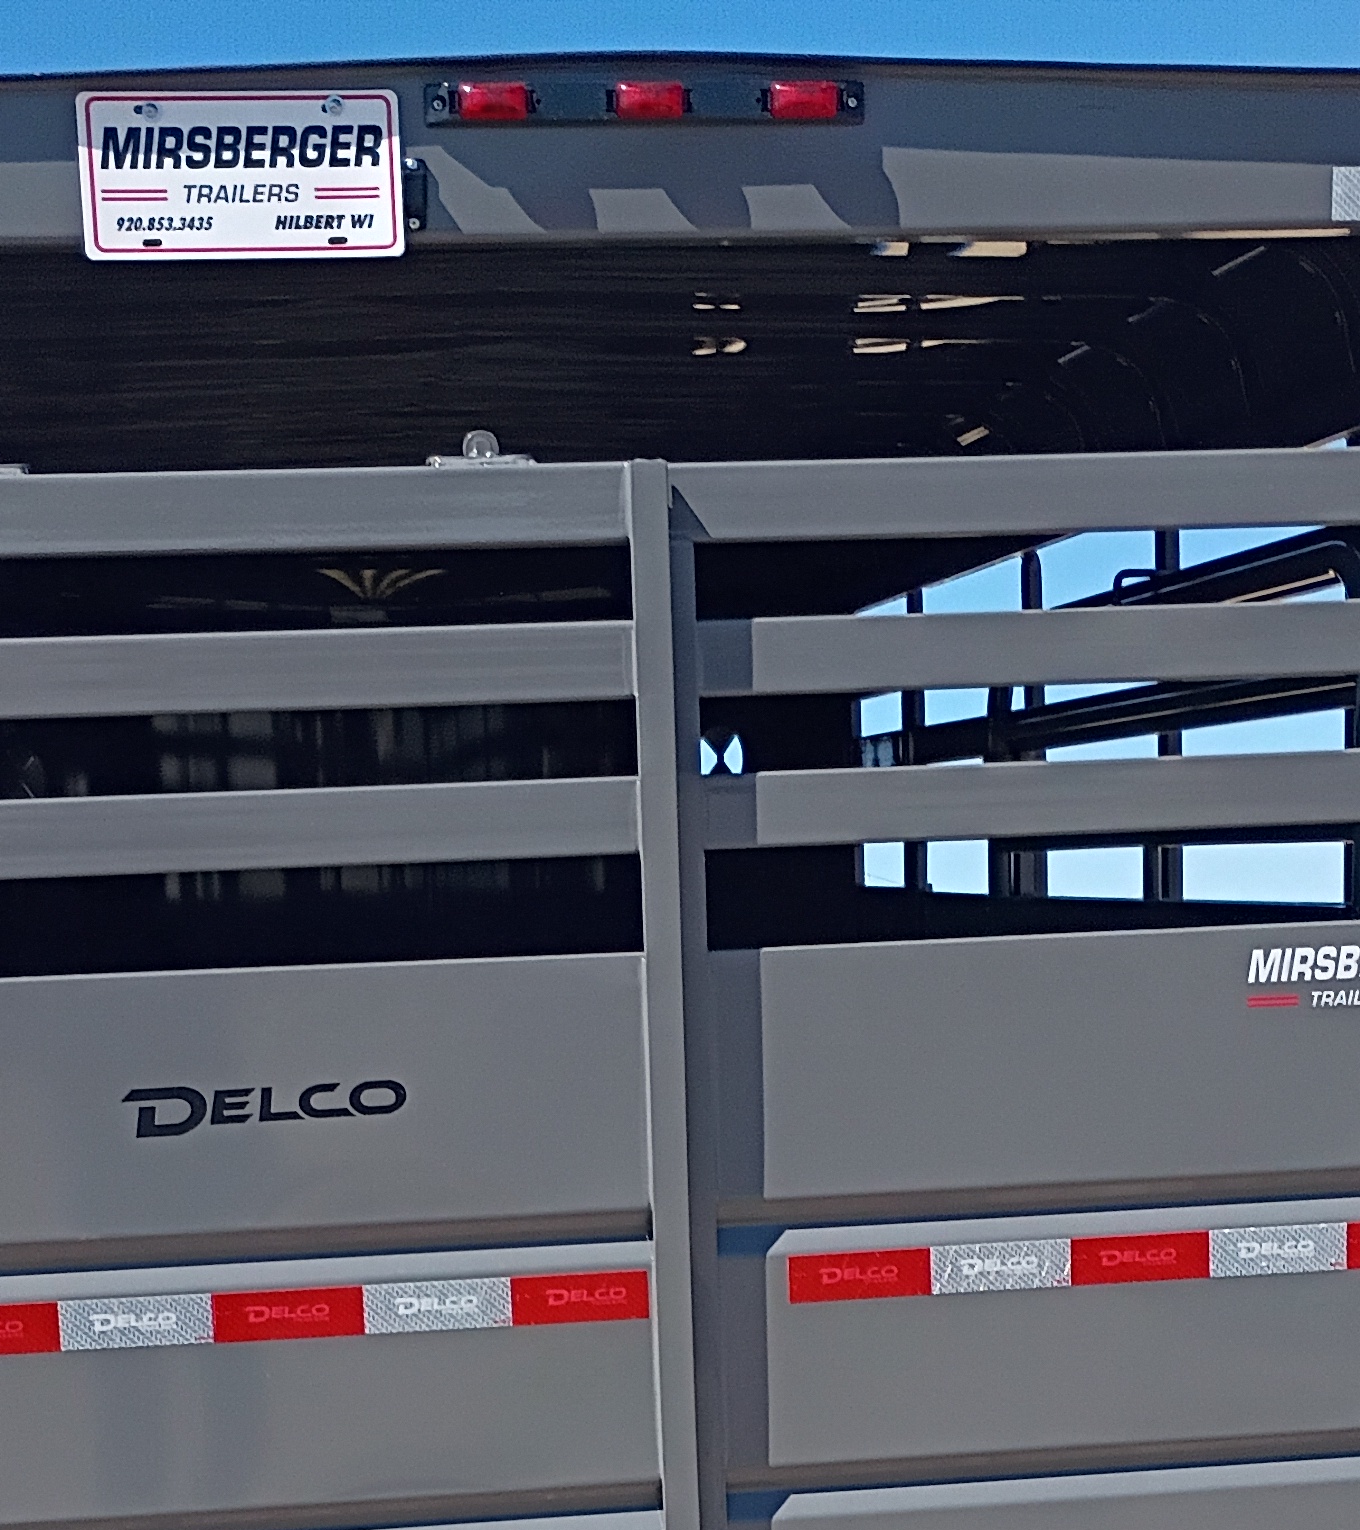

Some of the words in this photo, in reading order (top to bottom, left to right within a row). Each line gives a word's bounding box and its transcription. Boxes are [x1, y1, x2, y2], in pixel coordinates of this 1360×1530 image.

[100, 125, 383, 170] MIRSBERGER
[183, 183, 300, 204] TRAILERS
[115, 216, 214, 232] 920.853.3435
[274, 214, 346, 231] HILBERT
[349, 213, 375, 229] WI
[120, 1078, 408, 1139] DELCO
[545, 1287, 627, 1306] DELCO
[244, 1303, 330, 1323] DELCO
